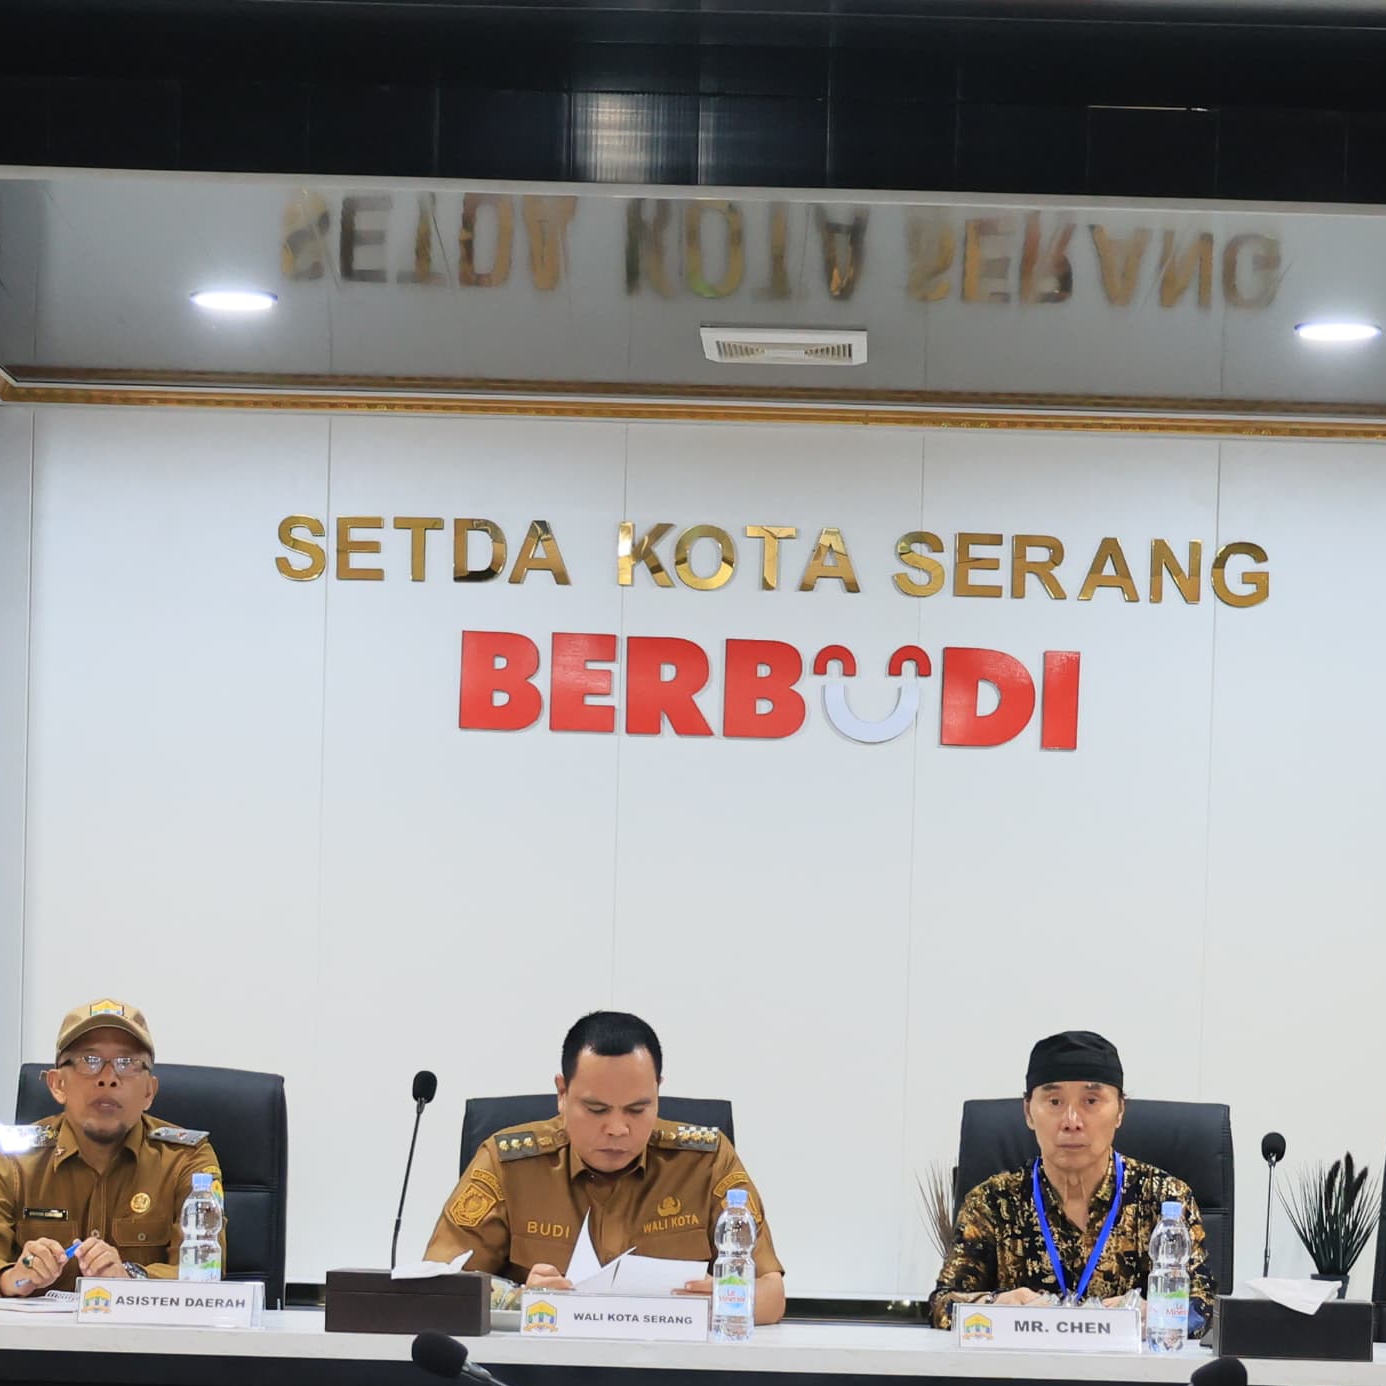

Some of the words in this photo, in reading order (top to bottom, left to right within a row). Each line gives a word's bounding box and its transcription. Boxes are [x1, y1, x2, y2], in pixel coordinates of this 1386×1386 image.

[275, 514, 572, 586] SETDA
[616, 522, 861, 595] KOTA
[894, 530, 1271, 609] SERANG
[459, 629, 1081, 751] BERBUDI
[527, 1221, 570, 1239] BUDI
[643, 1218, 668, 1233] WALI
[671, 1214, 700, 1229] KOTA
[115, 1295, 180, 1307] ASISTEN
[184, 1296, 246, 1309] DAERAH
[573, 1312, 604, 1322] WALI
[607, 1313, 640, 1323] KOTA
[643, 1313, 693, 1325] SERANG
[1013, 1319, 1049, 1333] MR.
[1056, 1320, 1111, 1335] CHEN
